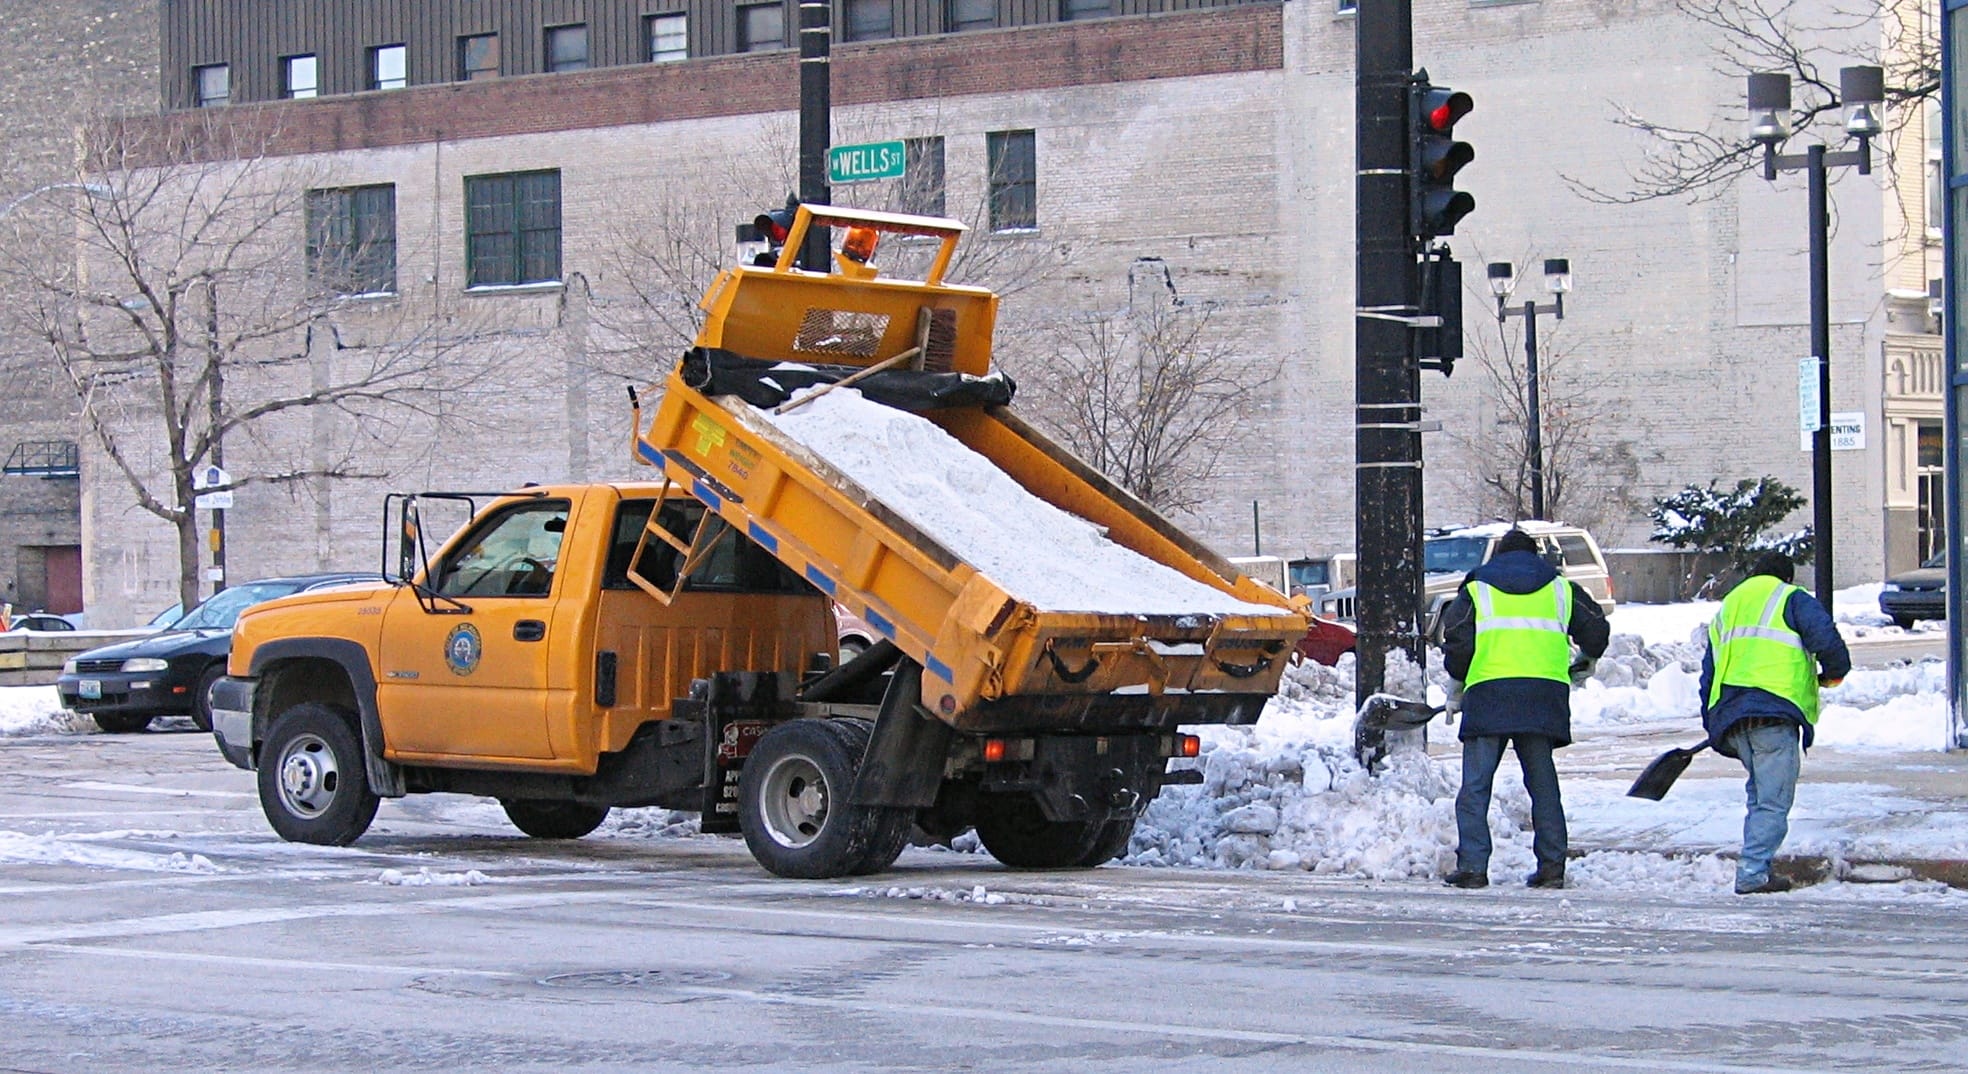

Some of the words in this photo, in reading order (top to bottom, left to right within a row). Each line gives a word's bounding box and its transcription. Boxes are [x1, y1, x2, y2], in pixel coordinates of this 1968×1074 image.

[832, 158, 839, 170] W
[839, 148, 889, 175] WELLS
[890, 152, 901, 165] ST
